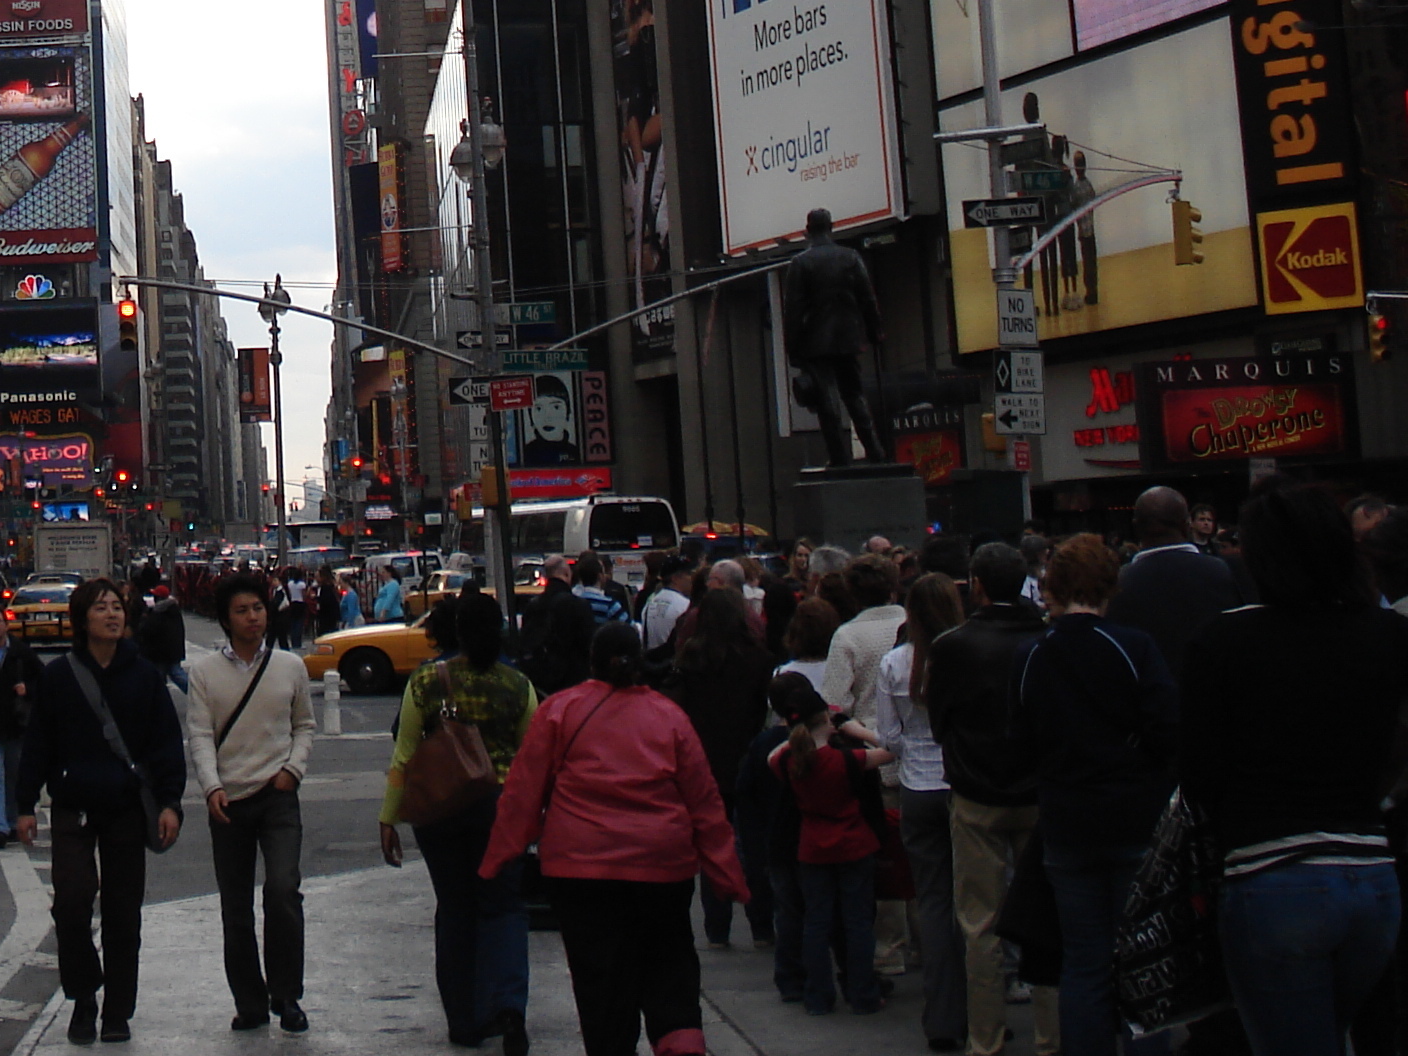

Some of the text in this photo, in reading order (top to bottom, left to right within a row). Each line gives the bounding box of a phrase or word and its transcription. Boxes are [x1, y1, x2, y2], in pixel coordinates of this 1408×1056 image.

[28, 18, 74, 31] FOODS
[754, 4, 827, 52] More bars
[741, 40, 849, 97] in more places.
[761, 120, 831, 172] cingular
[800, 150, 861, 182] raising the bar
[976, 205, 1034, 219] ONE WAY
[1286, 246, 1349, 271] Kodak
[512, 306, 522, 321] W
[525, 305, 540, 321] 46
[1007, 298, 1025, 314] NO
[1001, 317, 1034, 333] TURNS
[503, 350, 587, 363] LITTLE BRAZIL
[1017, 368, 1036, 377] BIKE
[1156, 357, 1342, 383] MARQUIS
[462, 384, 485, 396] ONE
[1016, 379, 1037, 388] LANE
[0, 390, 77, 403] Panasonic
[1001, 397, 1039, 407] WALK TO
[10, 408, 52, 424] WAGES
[585, 376, 607, 455] PEACE
[1019, 409, 1040, 418] NEXT
[1022, 420, 1041, 429] SIGN
[1190, 407, 1326, 459] Chaperone
